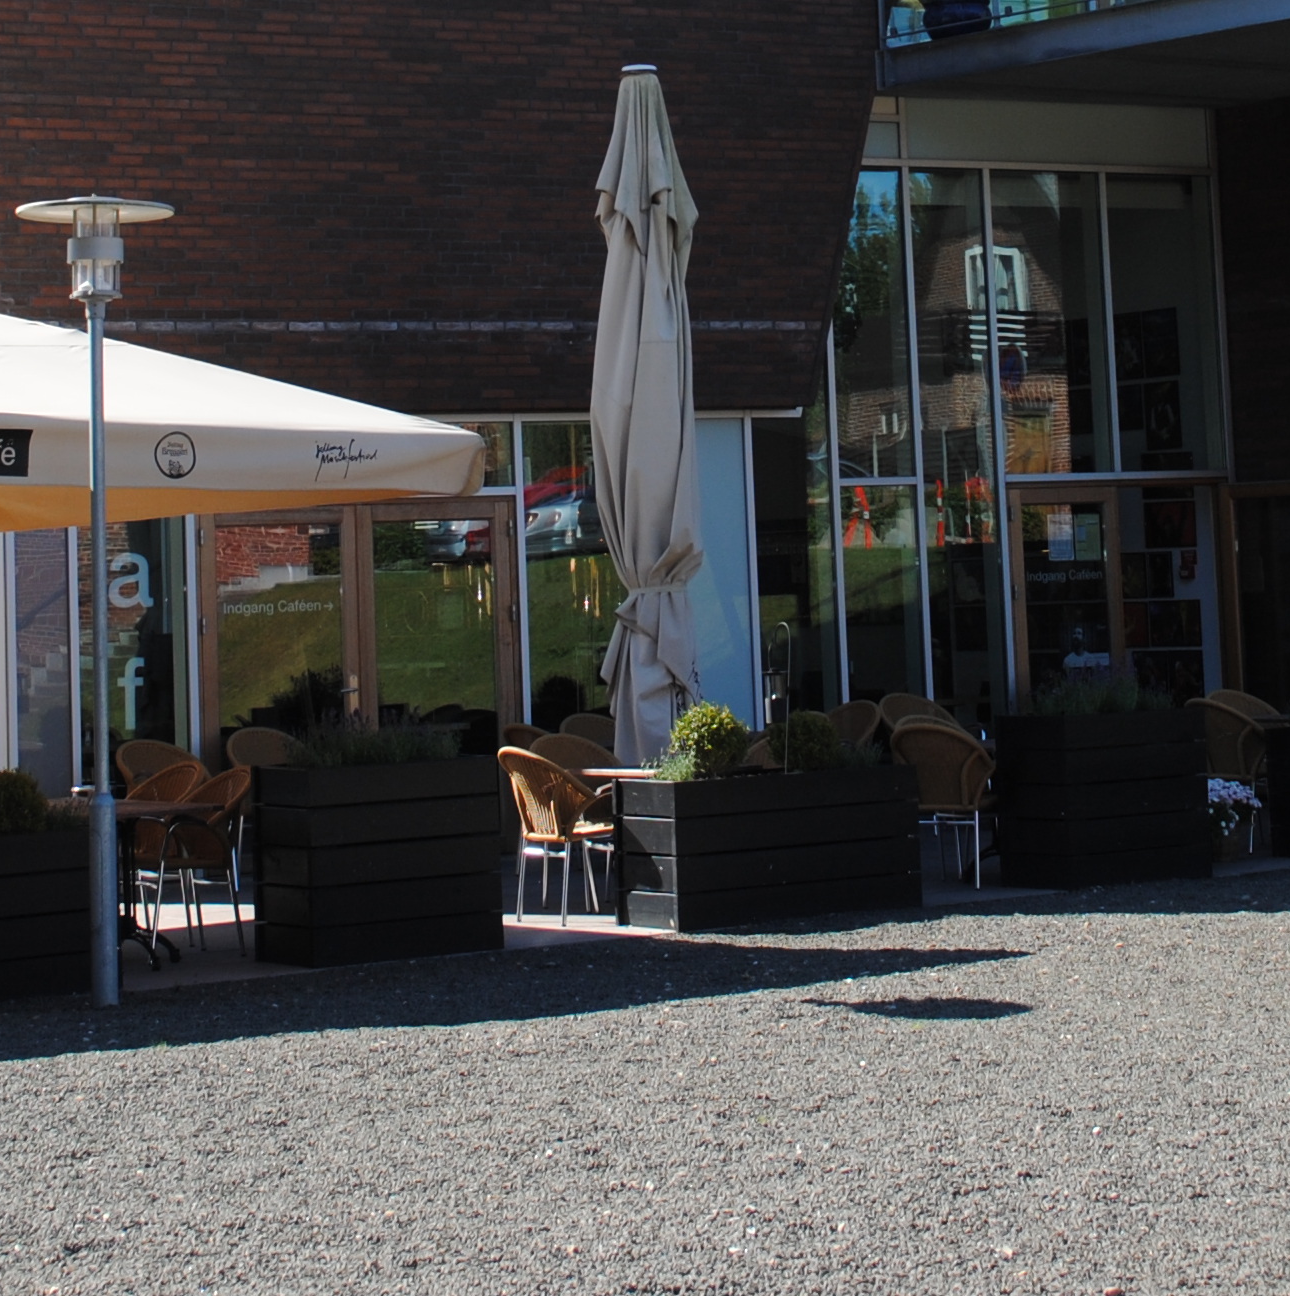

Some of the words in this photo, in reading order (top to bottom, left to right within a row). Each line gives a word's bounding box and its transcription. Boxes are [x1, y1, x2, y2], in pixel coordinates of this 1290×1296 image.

[1027, 571, 1067, 584] Indgang
[223, 602, 274, 617] Indgang
[278, 599, 322, 612] Caféen
